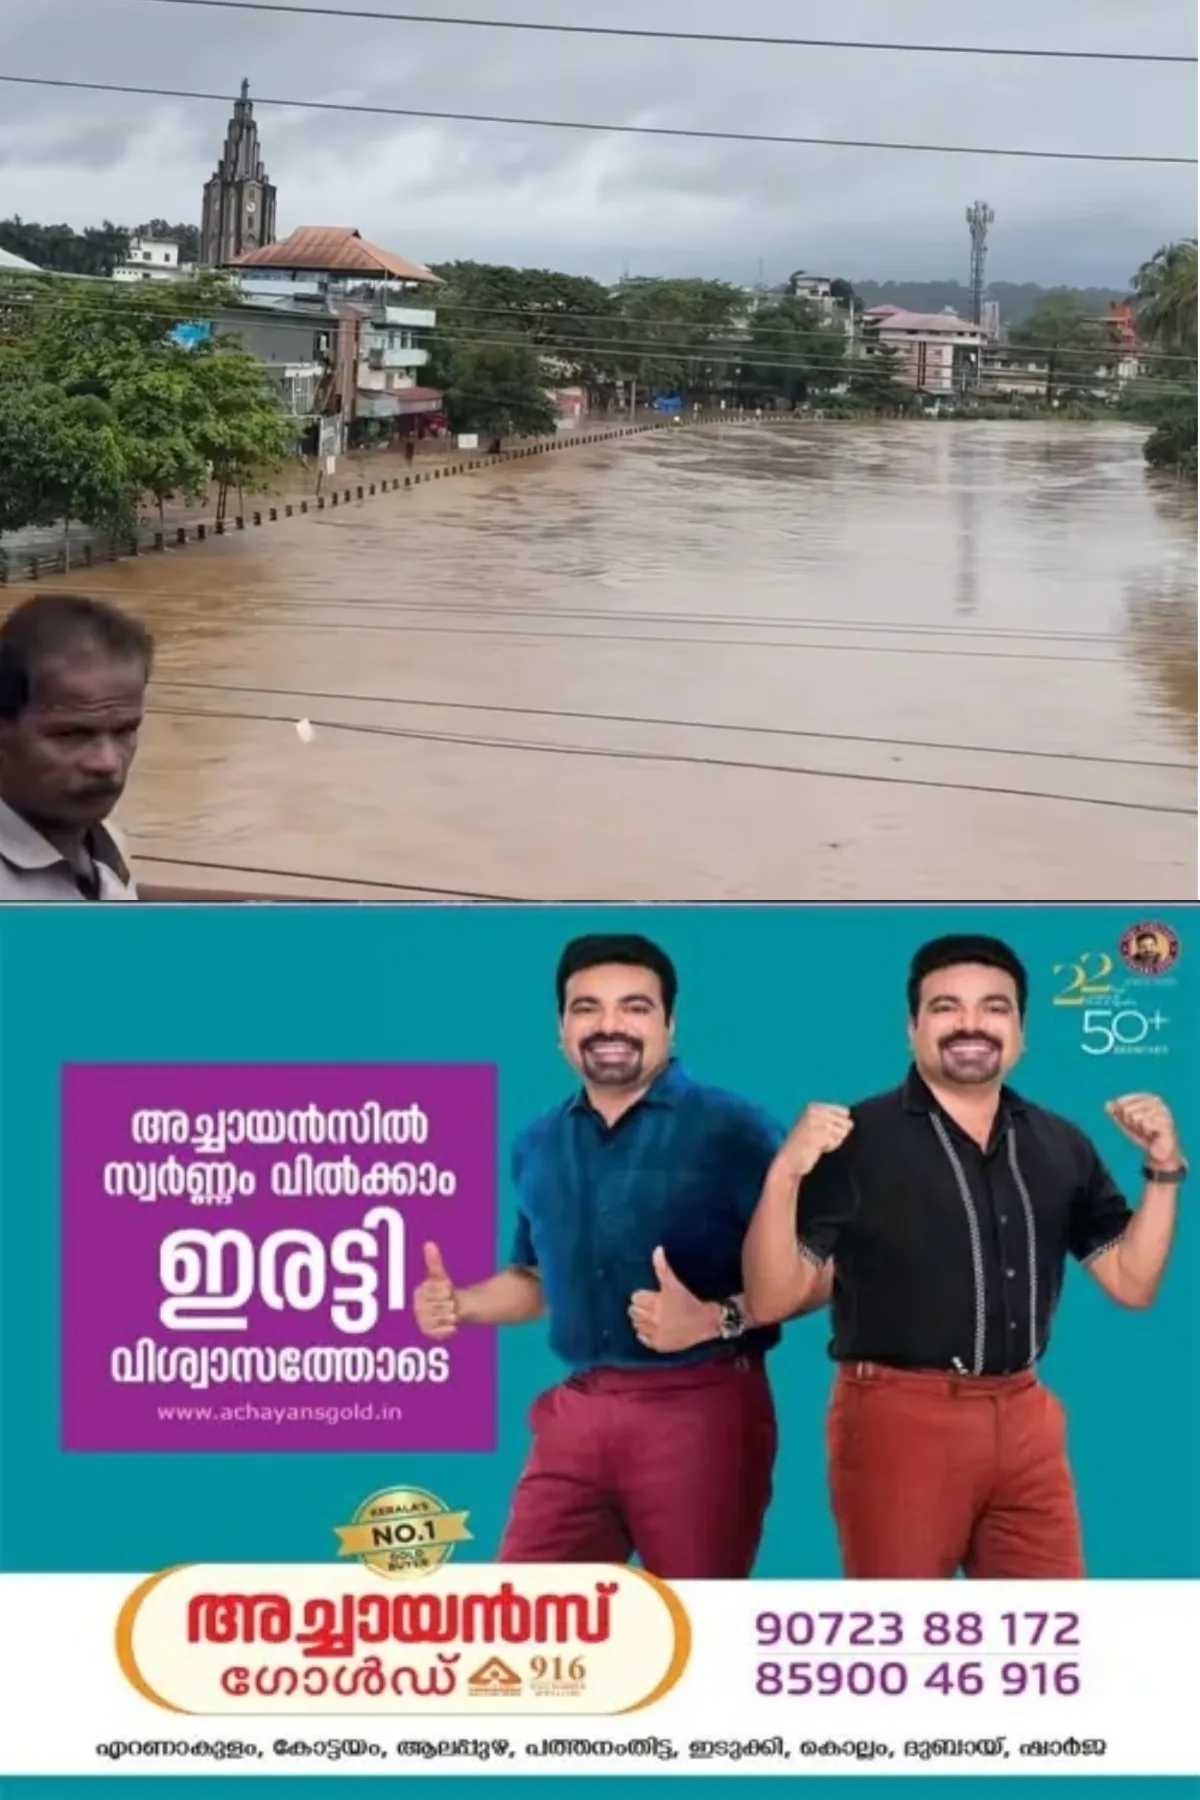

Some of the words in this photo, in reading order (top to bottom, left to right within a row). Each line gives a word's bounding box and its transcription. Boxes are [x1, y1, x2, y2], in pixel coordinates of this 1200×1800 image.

[1081, 1009, 1169, 1055] 50+
[131, 1101, 429, 1153] അച്ചായൻസിൽ
[103, 1156, 256, 1205] സ്വർണ്ണം
[271, 1153, 457, 1197] വിൽക്കാം
[159, 1206, 406, 1334] ഇരട്ടി
[111, 1337, 450, 1389] വിശ്വാസത്തോടെ
[157, 1403, 402, 1425] www.achayansgold.in
[372, 1520, 436, 1547] NO.1
[187, 1582, 618, 1658] അച്ചായൻസ്
[755, 1611, 903, 1646] 90723
[923, 1612, 983, 1646] 88
[1001, 1612, 1079, 1646] 172
[221, 1652, 461, 1696] ഗോൾഡ്
[530, 1655, 586, 1681] 916
[756, 1662, 908, 1696] 85900
[924, 1662, 983, 1695] 46
[1001, 1662, 1080, 1696] 916
[272, 1738, 387, 1760] കോട്ടയം,
[688, 1736, 791, 1760] ഇടുക്കി,
